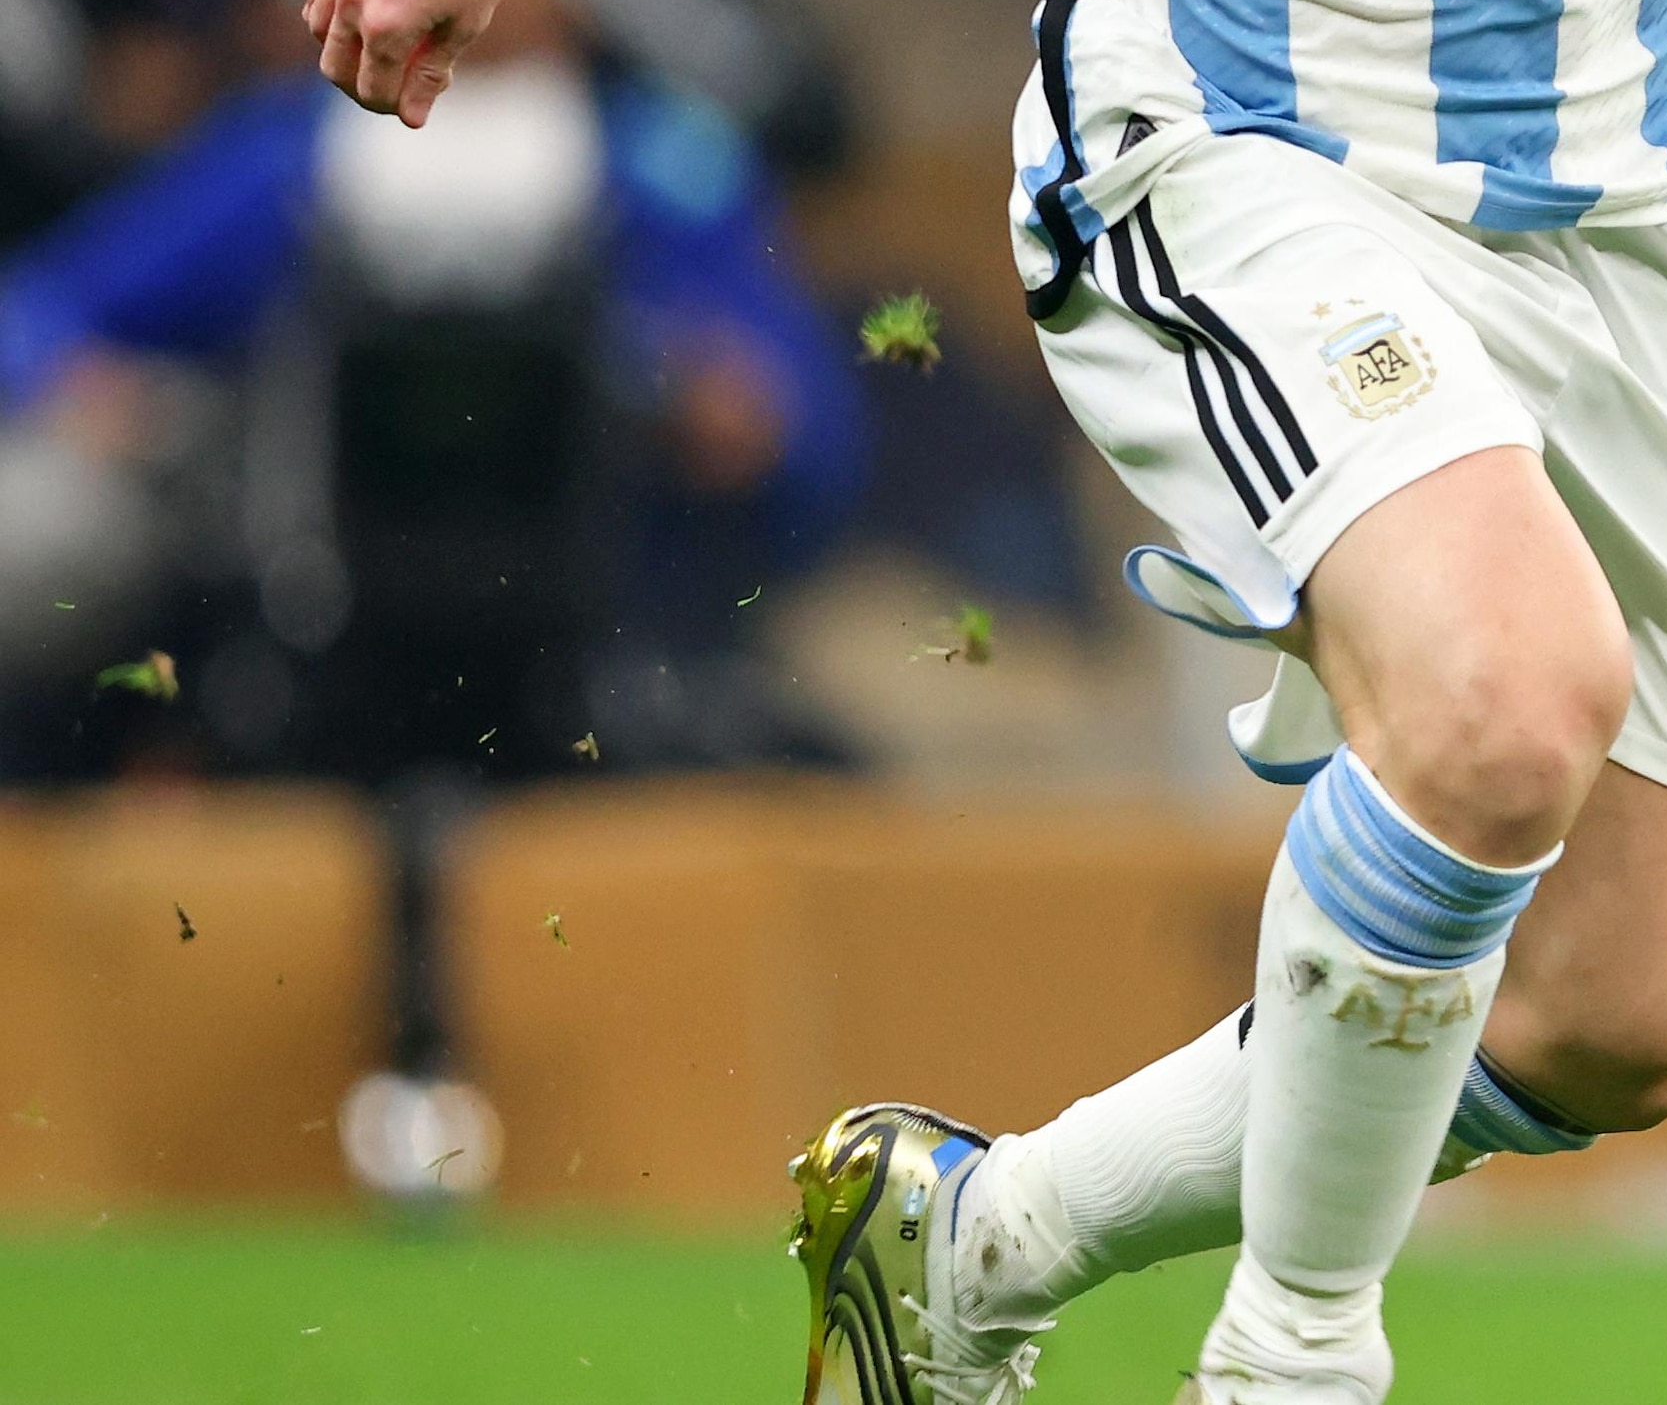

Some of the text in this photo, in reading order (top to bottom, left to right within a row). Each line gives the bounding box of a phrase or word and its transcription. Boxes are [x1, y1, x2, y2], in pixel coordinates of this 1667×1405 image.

[1352, 339, 1410, 390] AFA
[1328, 961, 1474, 1054] AFA
[900, 1219, 919, 1241] 10
